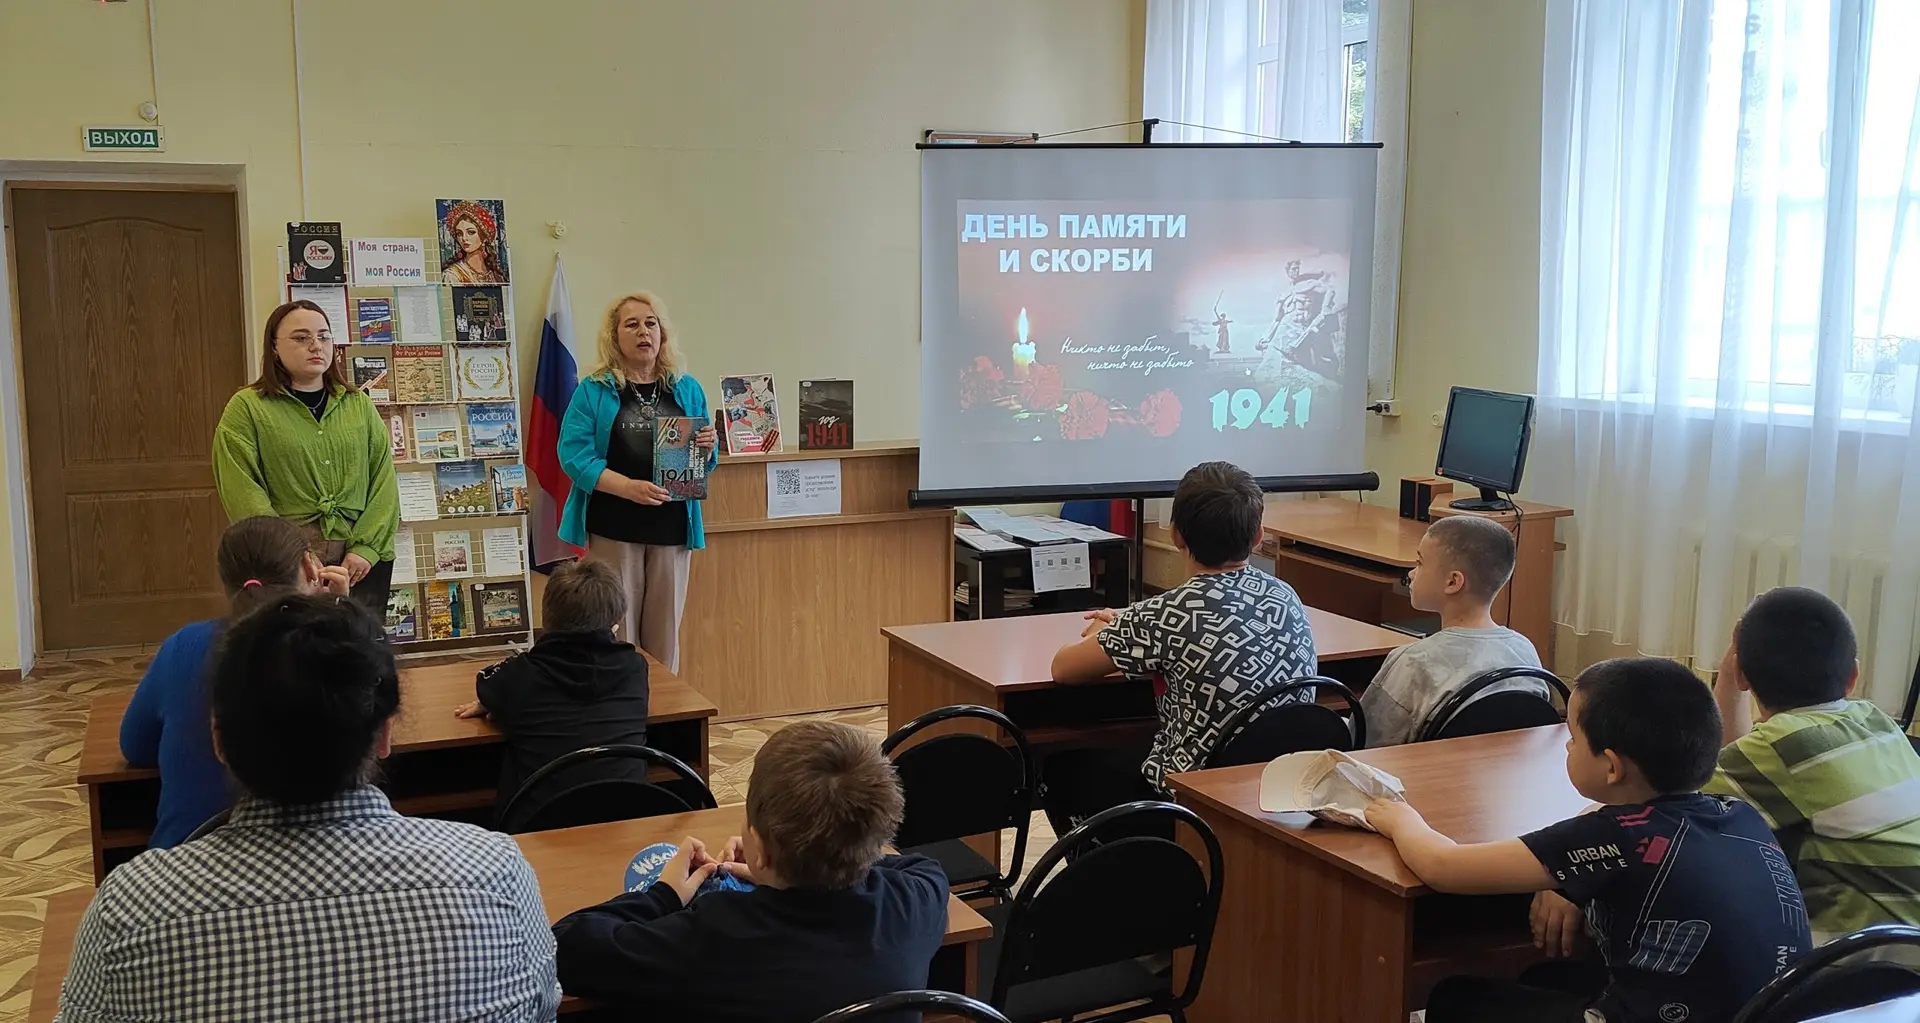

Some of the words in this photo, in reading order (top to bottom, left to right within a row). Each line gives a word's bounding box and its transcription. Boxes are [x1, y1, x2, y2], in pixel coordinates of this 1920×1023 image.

[91, 131, 156, 146] ВЫХОД
[961, 214, 1049, 243] ДЕНЬ
[1058, 213, 1188, 239] ПАМЯТИ
[309, 245, 318, 256] Я
[357, 241, 377, 252] Моя
[382, 244, 418, 255] страна,
[365, 267, 384, 277] моя
[386, 264, 421, 278] Россия
[999, 249, 1020, 273] И
[1029, 248, 1153, 273] СКОРБИ
[1060, 336, 1105, 354] Никто
[1107, 343, 1121, 353] не
[1123, 334, 1171, 360] забыт,
[1086, 359, 1127, 370] ничто
[1129, 359, 1144, 369] не
[1145, 350, 1195, 376] забыто
[471, 412, 514, 422] РОССИИ
[1208, 385, 1313, 433] 1941
[813, 415, 840, 429] год
[806, 421, 849, 449] 1941
[660, 468, 695, 487] 1941
[664, 479, 708, 498] 1945
[1567, 843, 1622, 864] URBAN
[1556, 858, 1629, 881] STYLE
[1628, 919, 1712, 976] NO
[1775, 945, 1788, 974] BAN
